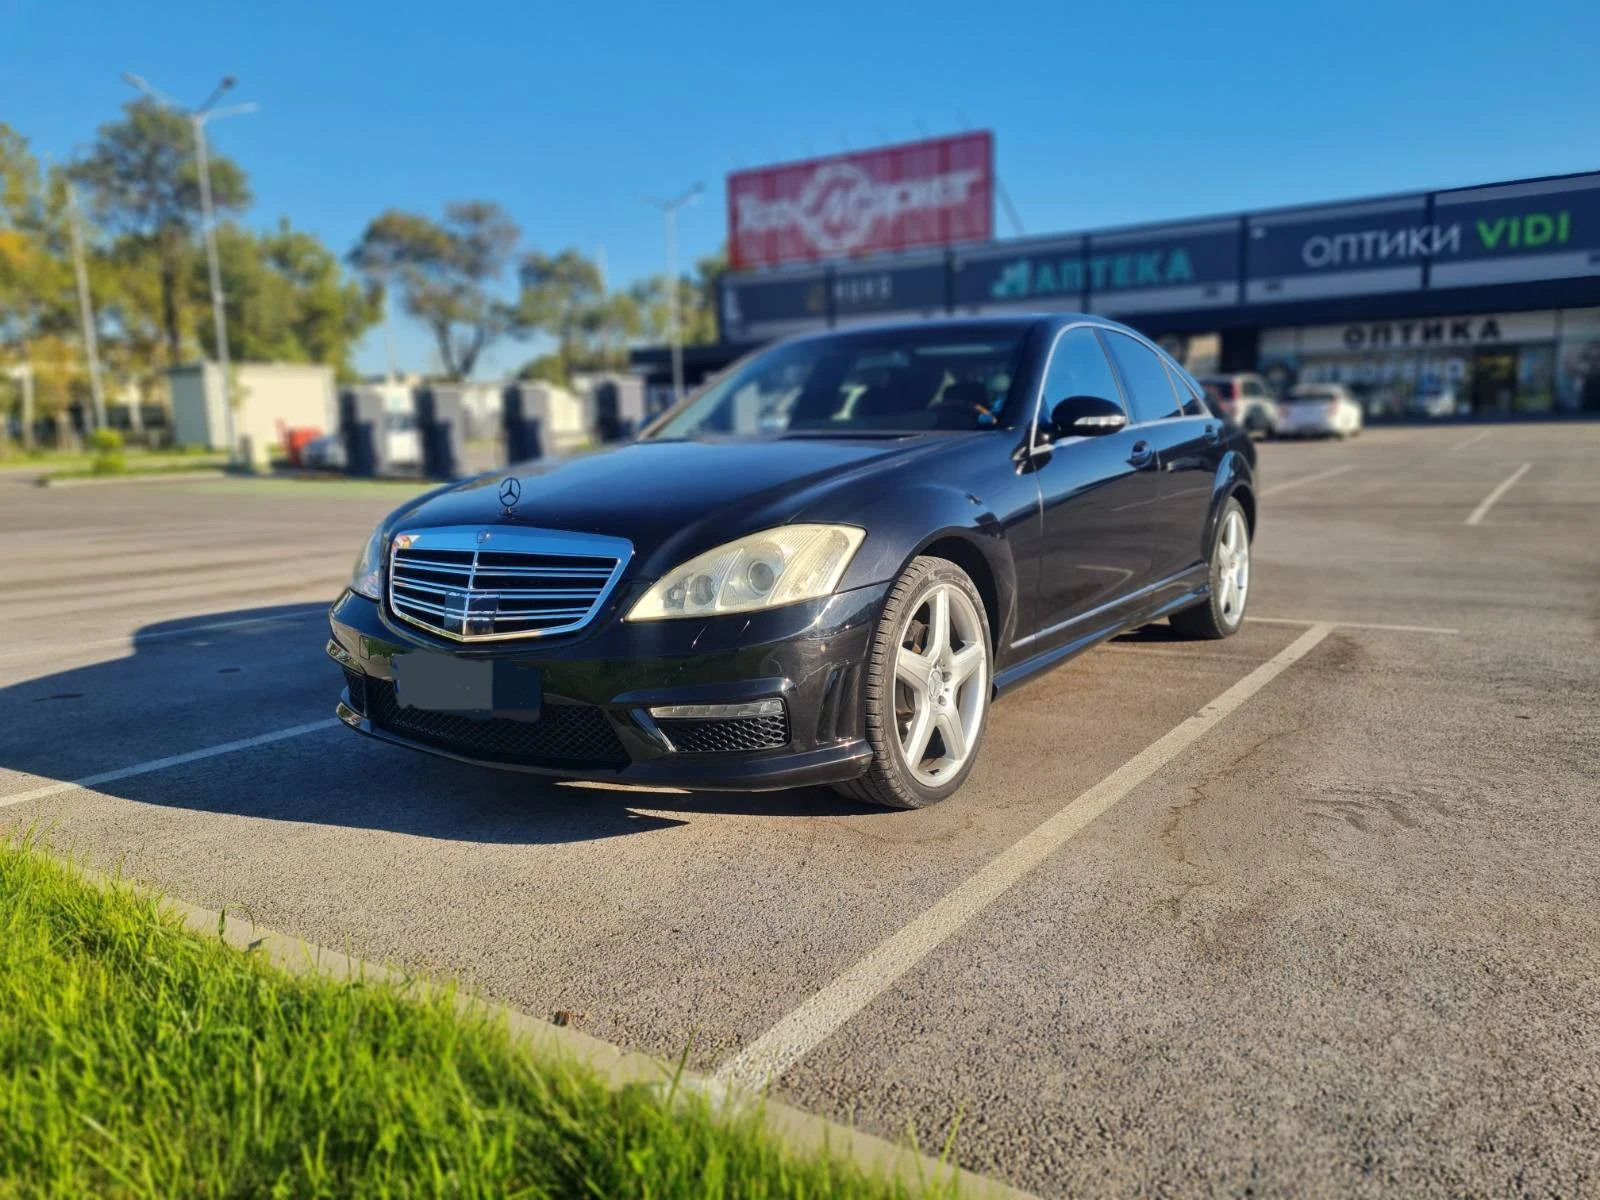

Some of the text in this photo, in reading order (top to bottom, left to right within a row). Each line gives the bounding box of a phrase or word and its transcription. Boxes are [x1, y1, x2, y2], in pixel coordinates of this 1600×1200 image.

[1301, 209, 1571, 268] ОПТИКИ VIDI
[1036, 249, 1194, 293] АПТЕКА
[1343, 317, 1503, 349] ОПТИКА
